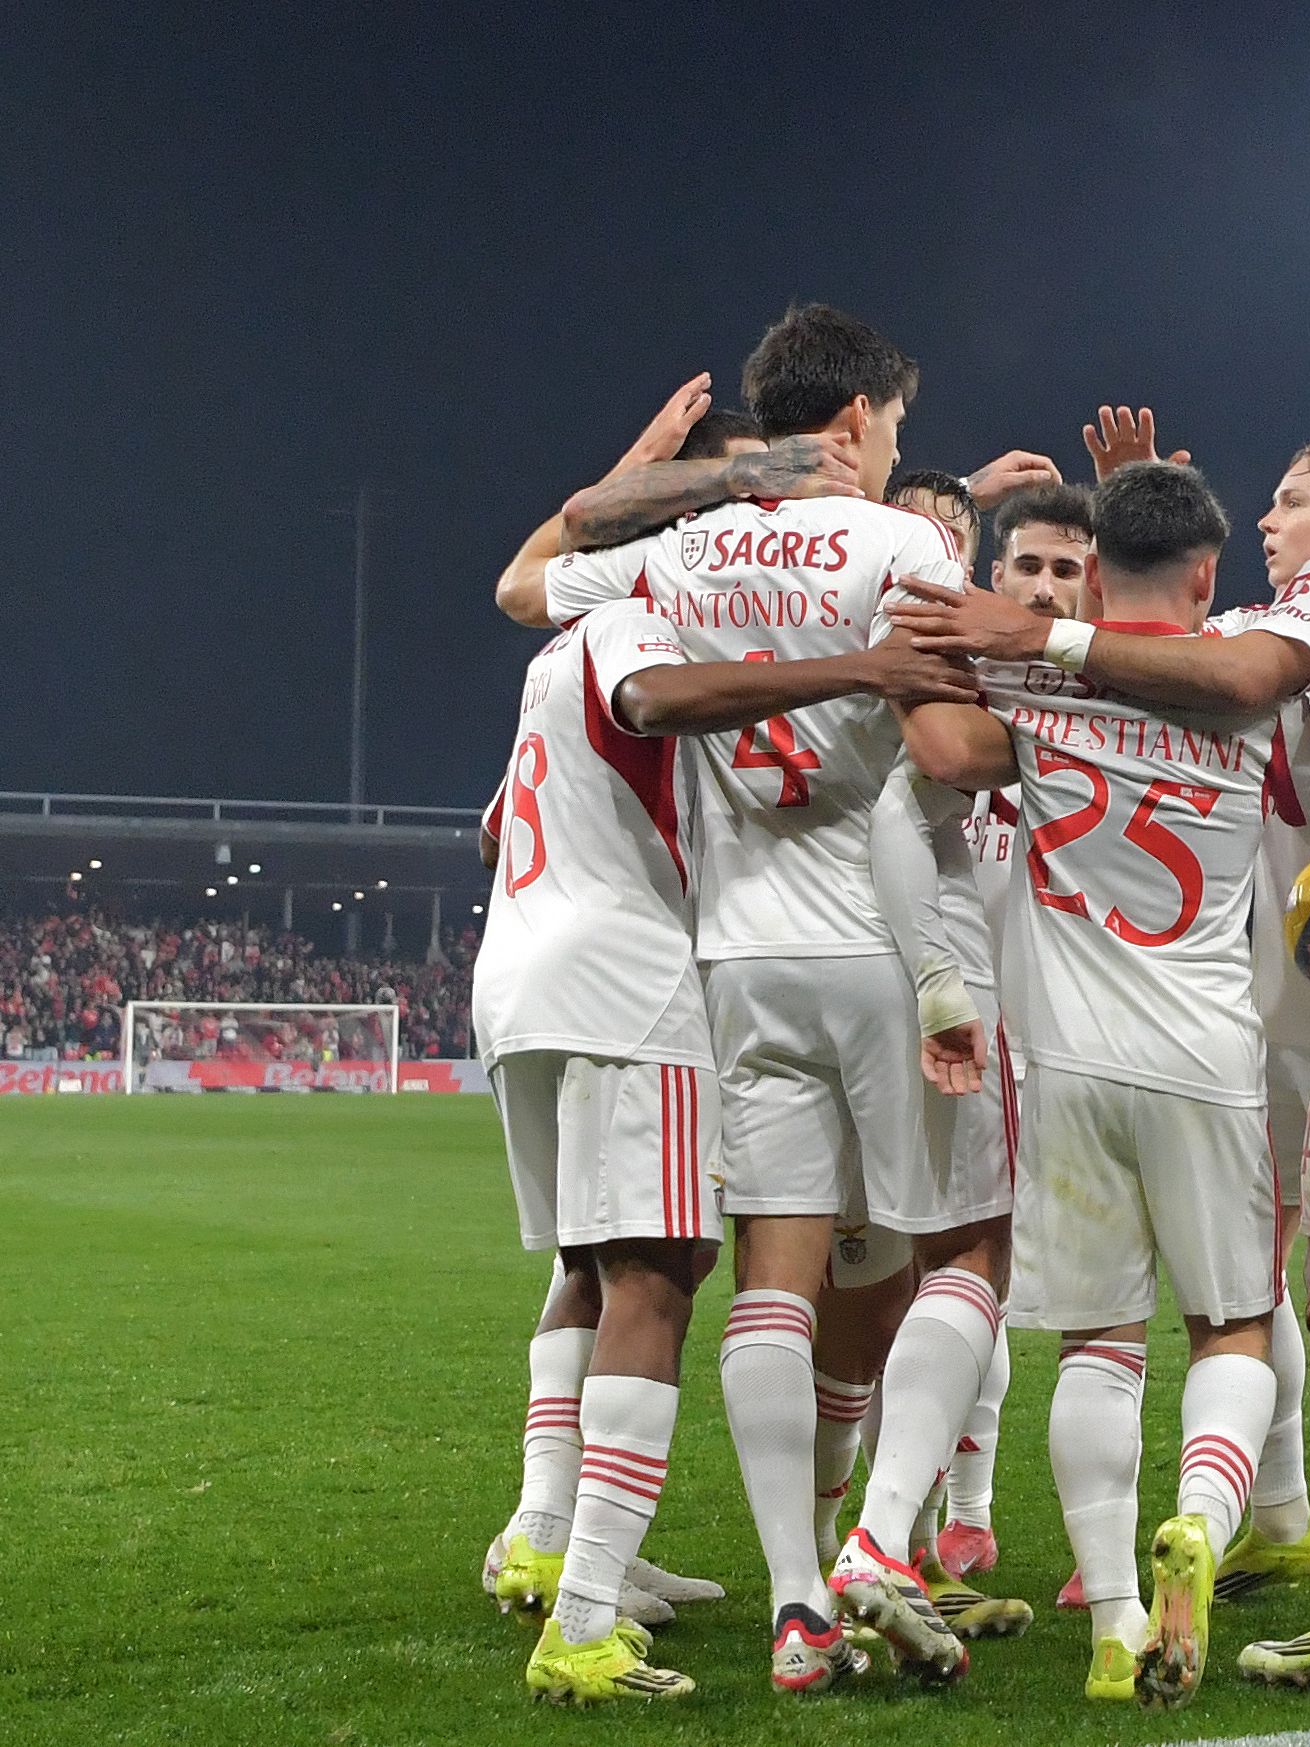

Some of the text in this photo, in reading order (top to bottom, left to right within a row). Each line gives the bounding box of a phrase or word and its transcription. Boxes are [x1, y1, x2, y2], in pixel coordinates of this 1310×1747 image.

[708, 529, 849, 572] SAGRES
[668, 583, 851, 629] ANTÓNIO S.
[731, 650, 822, 808] 4
[1010, 707, 1246, 773] PRESTIANNI
[1026, 744, 1224, 948] 25
